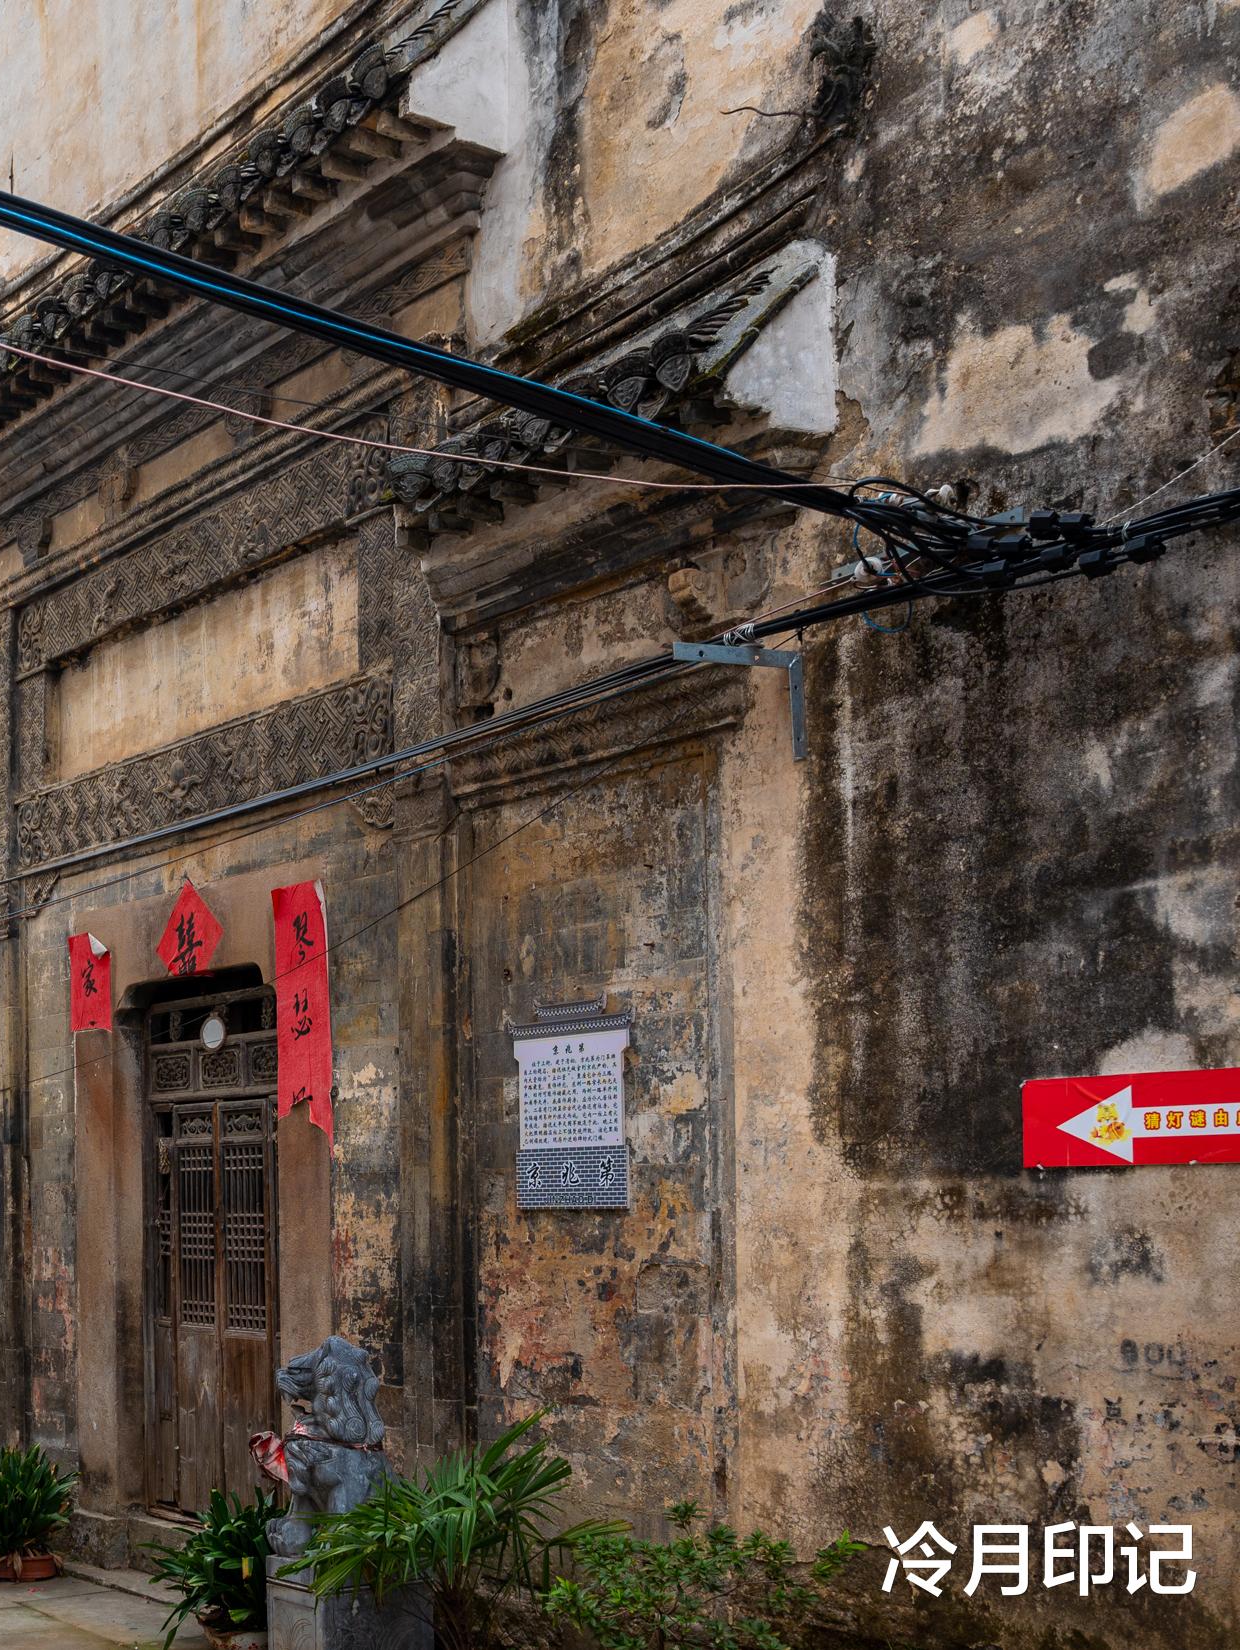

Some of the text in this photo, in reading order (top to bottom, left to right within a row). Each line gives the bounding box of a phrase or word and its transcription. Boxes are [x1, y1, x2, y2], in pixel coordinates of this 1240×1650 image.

[1143, 1107, 1240, 1130] 猜灯谜由
[525, 1155, 616, 1190] 京兆第
